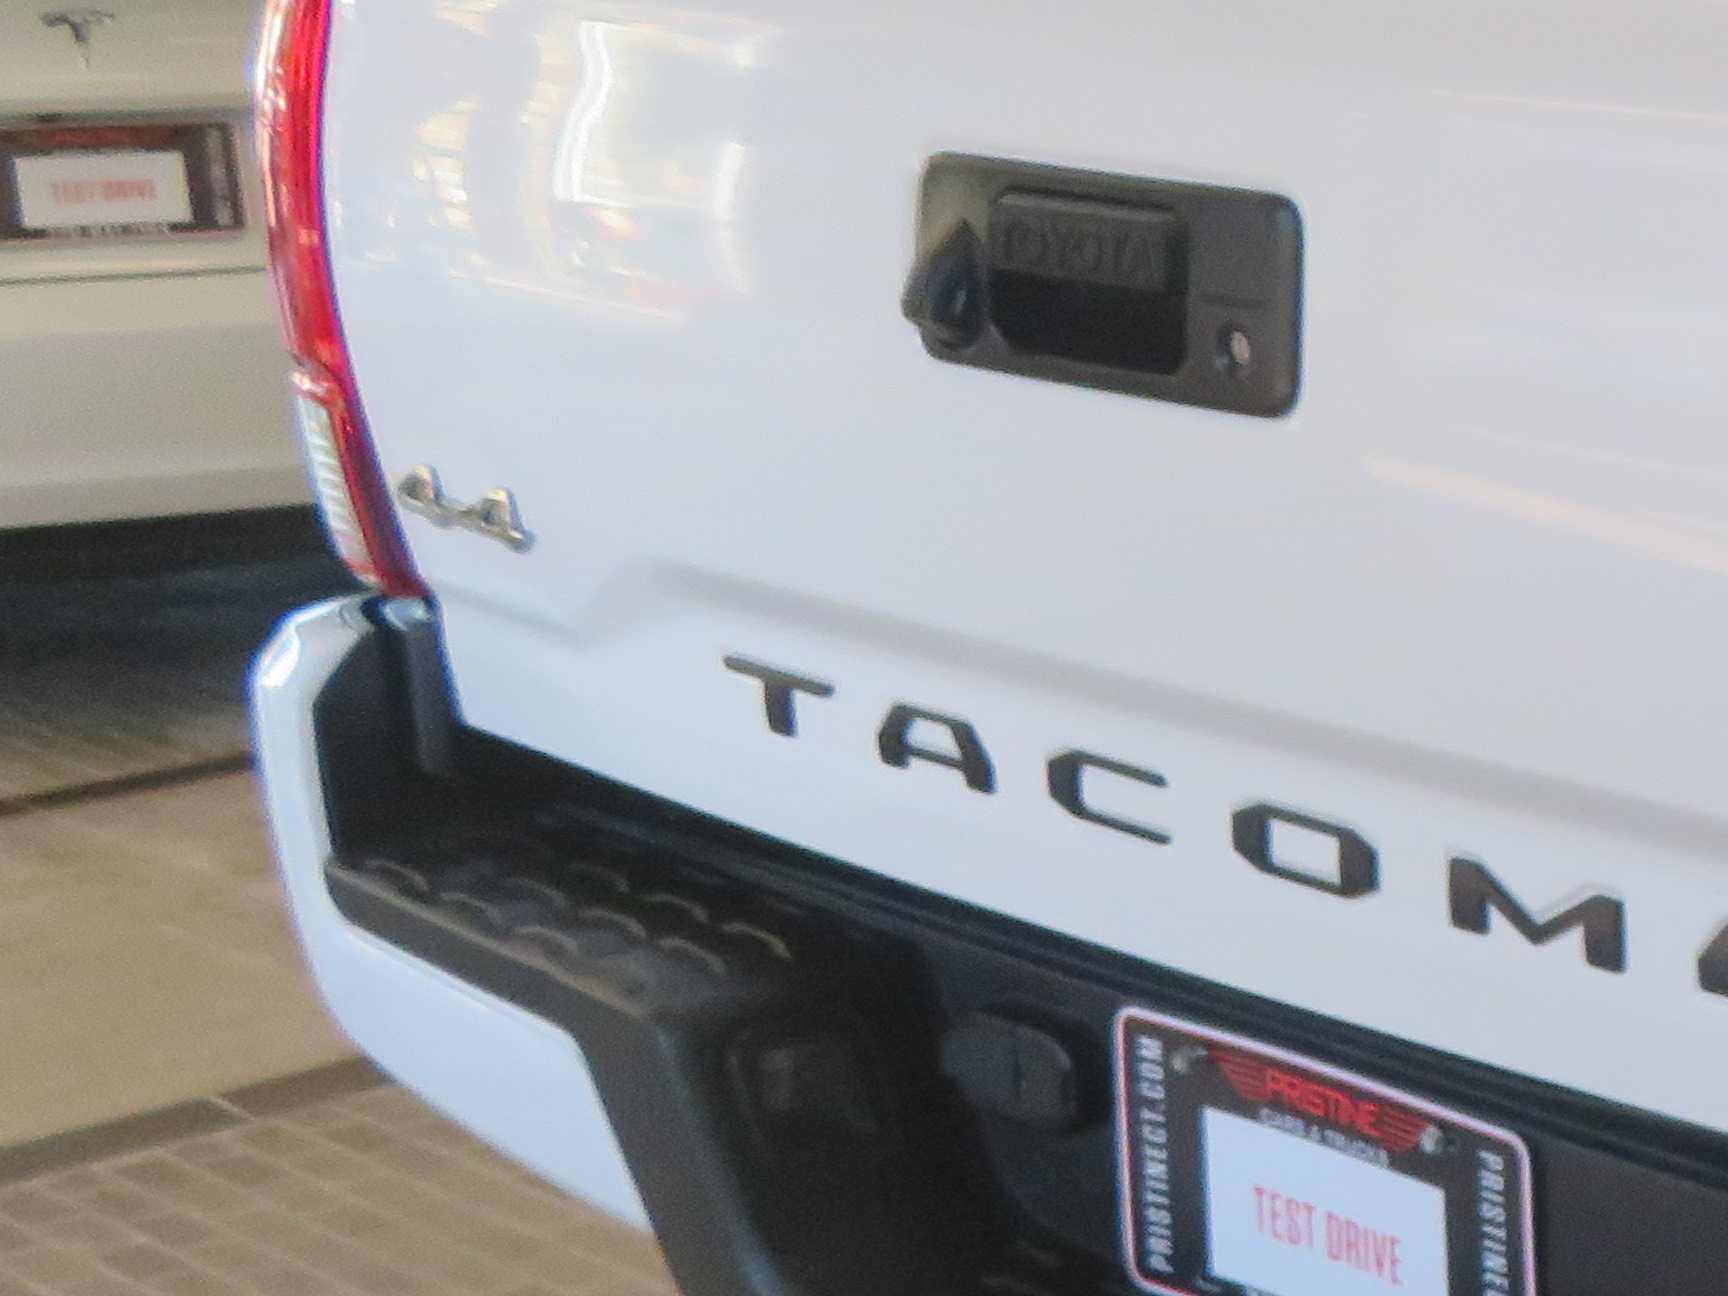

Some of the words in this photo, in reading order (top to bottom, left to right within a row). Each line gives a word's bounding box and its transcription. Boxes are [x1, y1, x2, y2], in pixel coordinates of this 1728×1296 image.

[1264, 1069, 1382, 1137] PRISTINE
[1252, 1186, 1316, 1247] TEST
[1324, 1210, 1404, 1287] DRIVE
